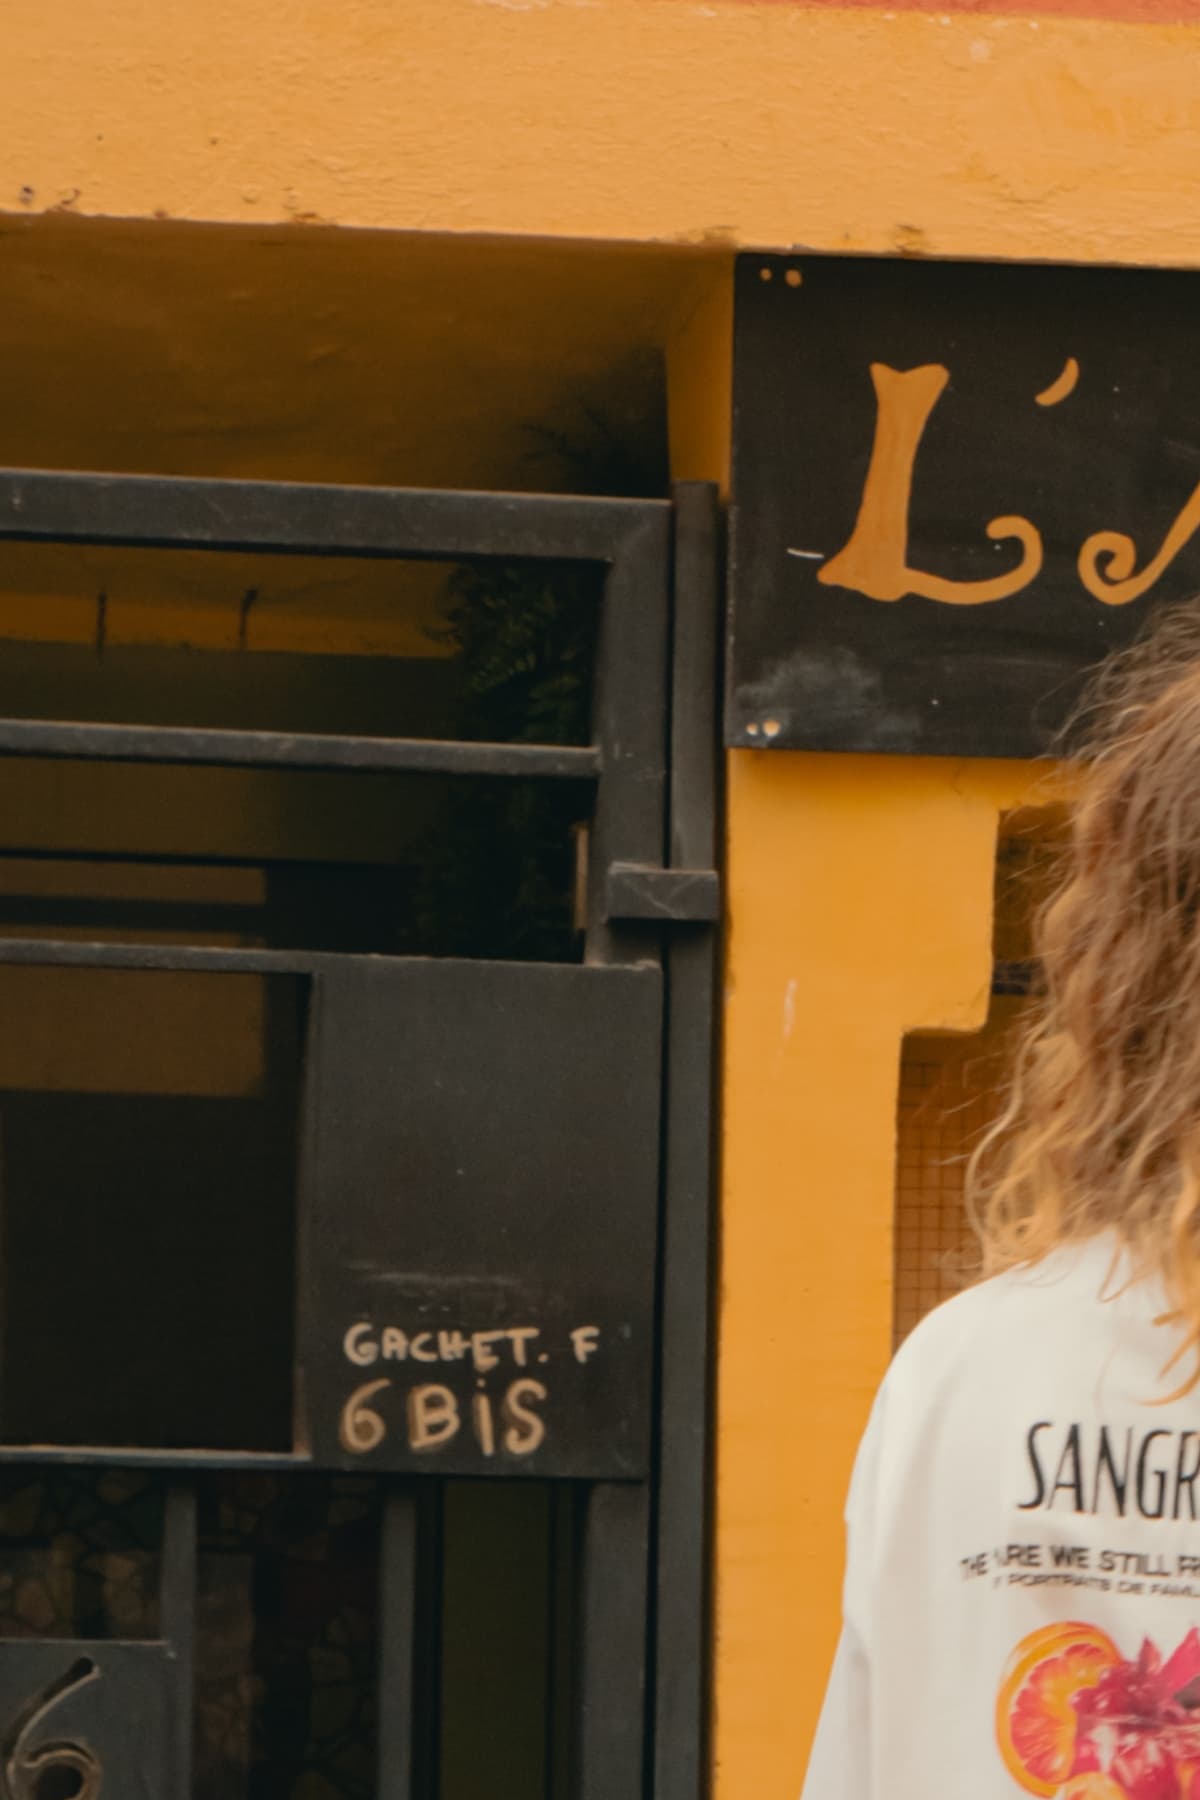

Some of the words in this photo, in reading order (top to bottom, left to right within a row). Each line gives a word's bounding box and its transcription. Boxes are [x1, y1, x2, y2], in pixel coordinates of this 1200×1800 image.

[569, 1325, 601, 1364] F
[340, 1378, 391, 1454] 6
[1049, 1544, 1090, 1569] WE
[1098, 1549, 1171, 1578] STILL
